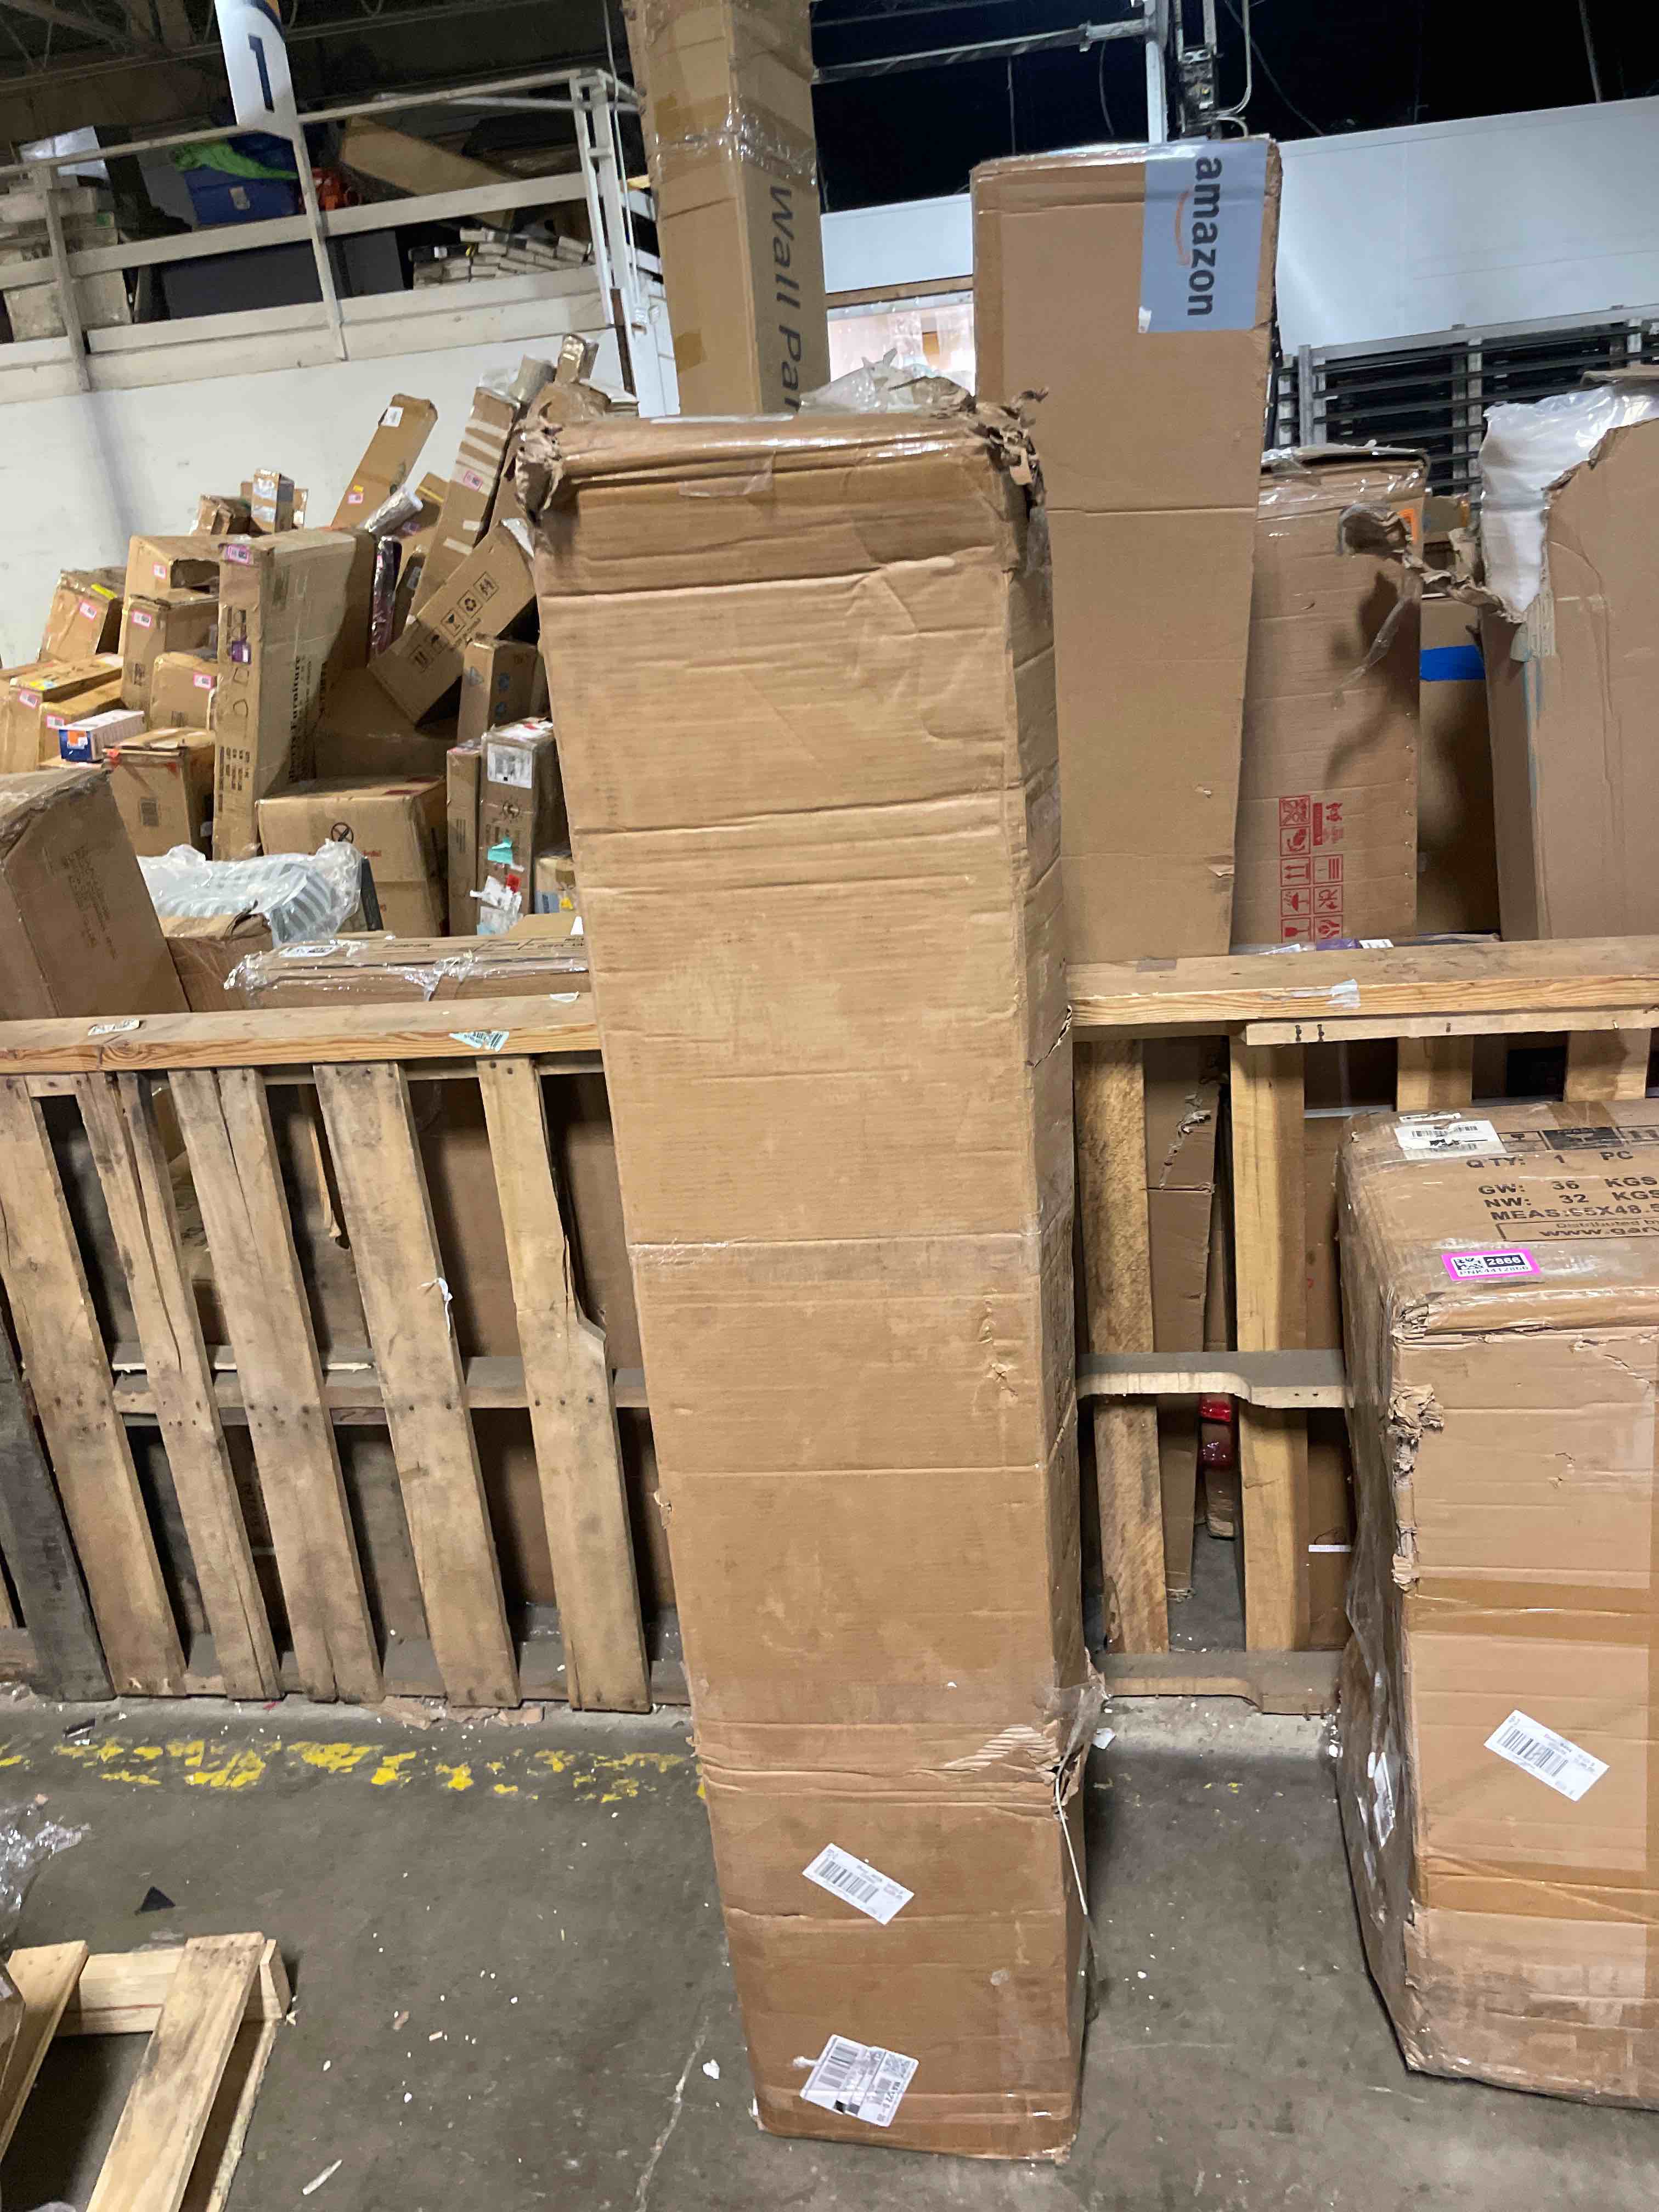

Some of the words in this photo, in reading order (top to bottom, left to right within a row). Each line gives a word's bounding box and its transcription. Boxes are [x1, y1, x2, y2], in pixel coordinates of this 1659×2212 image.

[247, 33, 275, 113] 1
[1187, 157, 1223, 316] amazon
[770, 186, 801, 310] Wall
[1554, 1154, 1565, 1163] 1
[1599, 1150, 1634, 1161] PC
[1478, 1183, 1525, 1194] GW:
[1552, 1180, 1579, 1190] 36
[1604, 1176, 1658, 1188] KGS
[1483, 1197, 1532, 1208] NW:
[1559, 1194, 1589, 1204] 32
[1611, 1189, 1659, 1201] KGS
[1486, 1256, 1521, 1266] 2866
